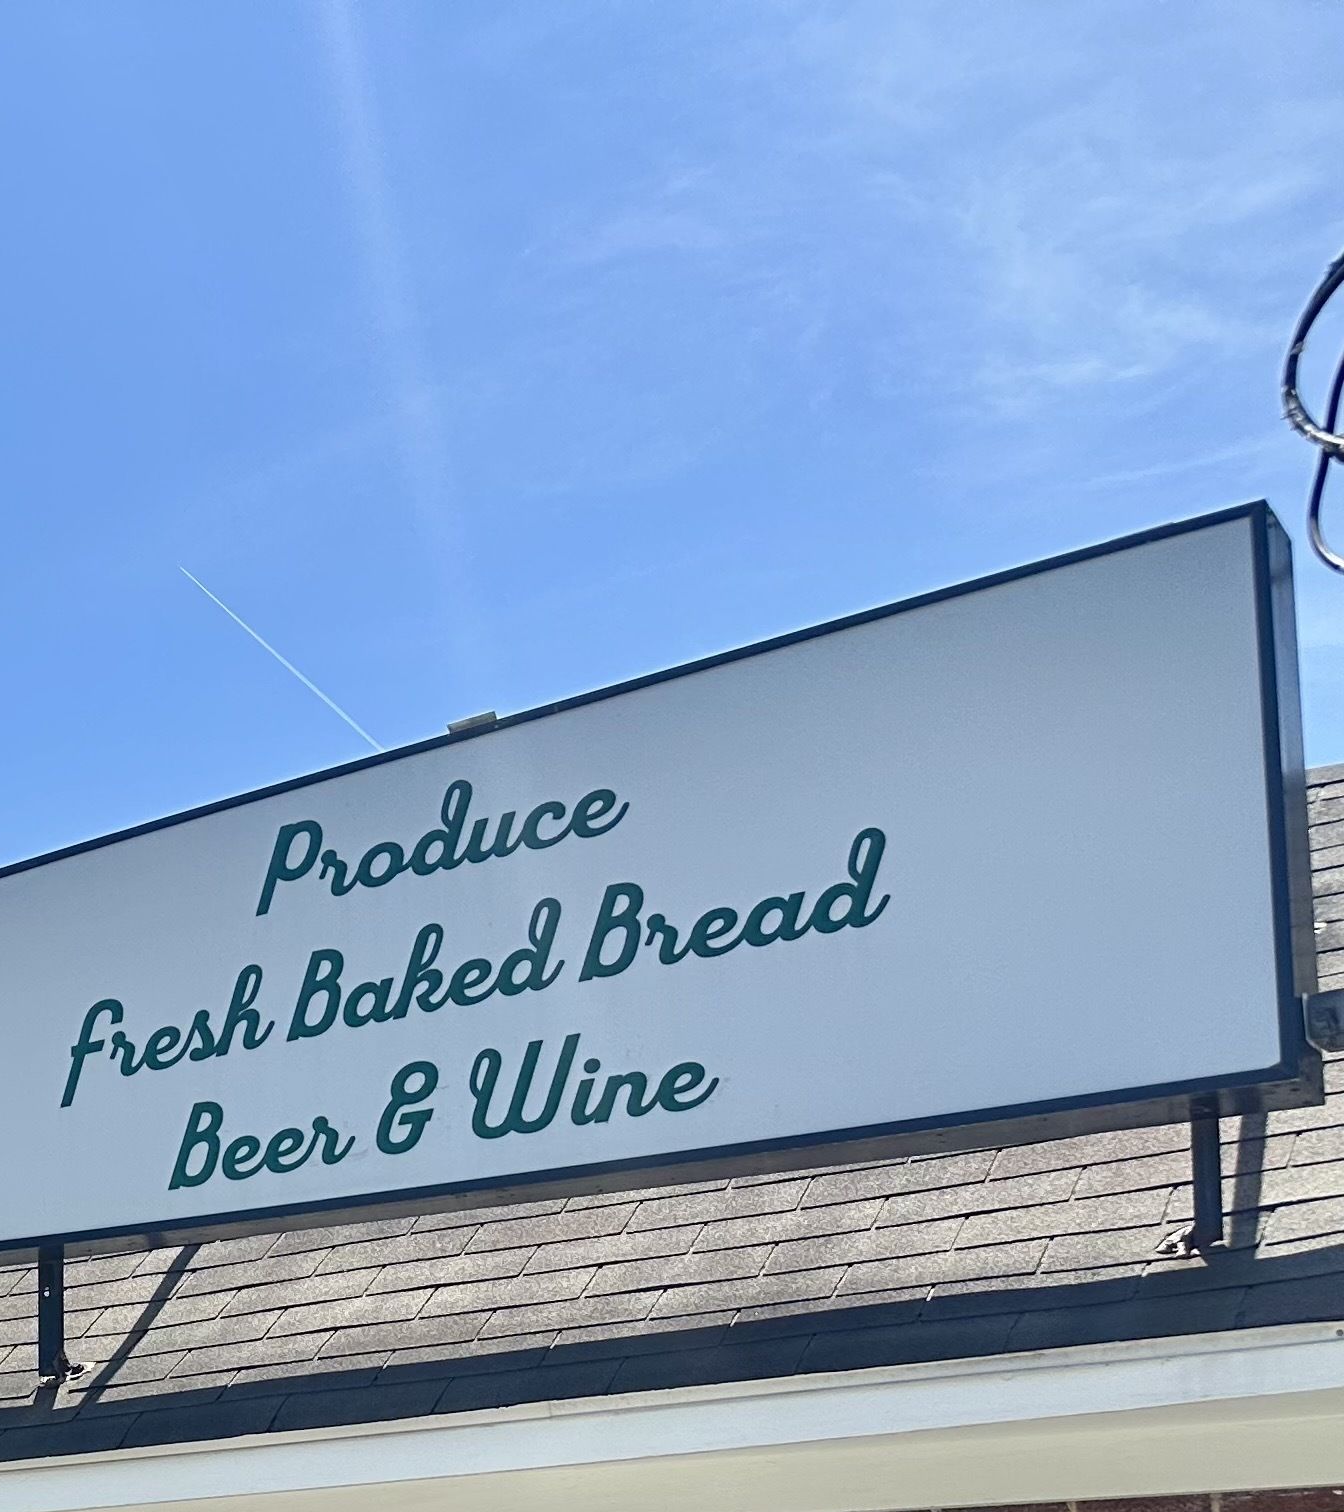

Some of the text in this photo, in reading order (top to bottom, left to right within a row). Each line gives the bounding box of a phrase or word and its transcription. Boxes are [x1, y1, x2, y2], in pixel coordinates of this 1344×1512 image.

[255, 780, 629, 916] Produce
[285, 898, 565, 1042] Baked
[578, 828, 891, 982] Bread
[167, 1033, 720, 1190] Beer & Wine
